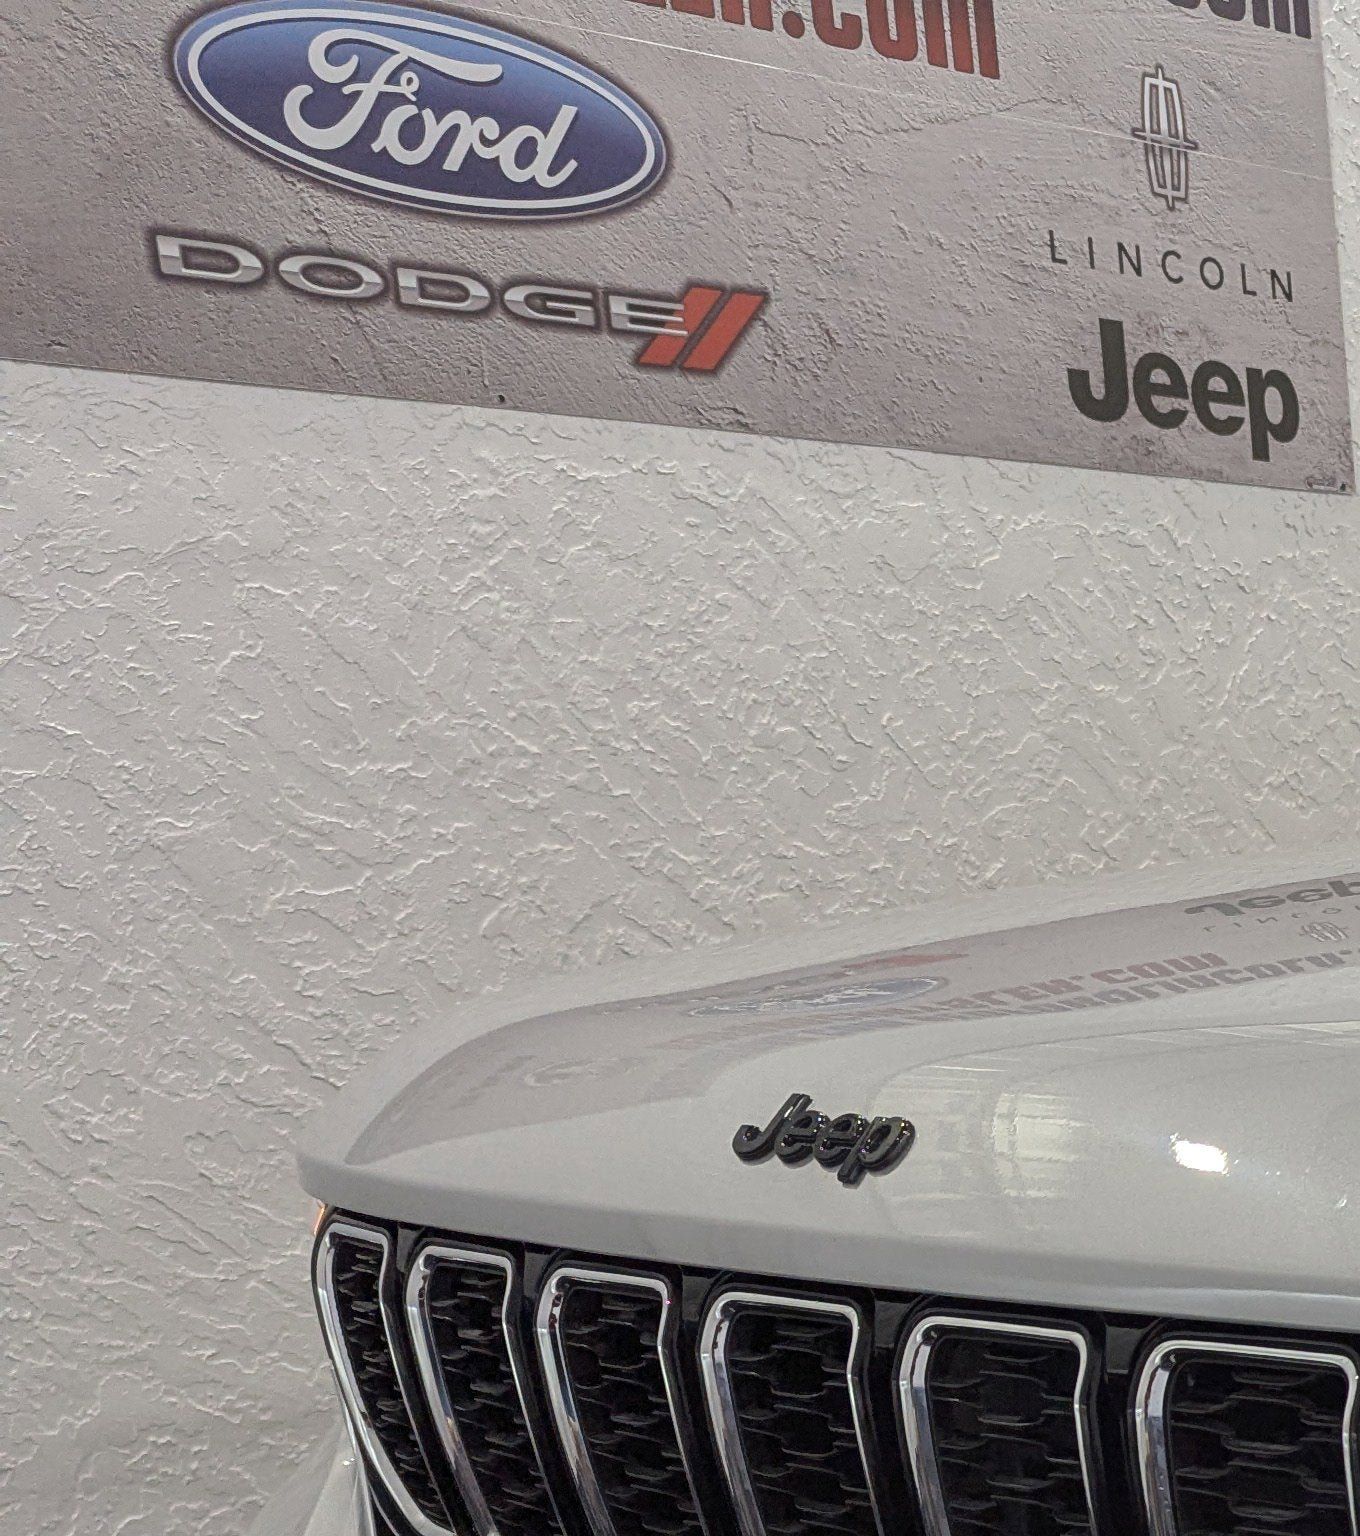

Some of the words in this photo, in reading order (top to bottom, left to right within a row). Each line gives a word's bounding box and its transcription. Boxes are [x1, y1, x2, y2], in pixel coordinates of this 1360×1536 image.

[284, 28, 579, 189] Ford
[154, 234, 690, 337] DODGE
[1049, 229, 1294, 303] LINCOLN
[1066, 317, 1301, 463] Jeep
[732, 1093, 916, 1187] Jeep
